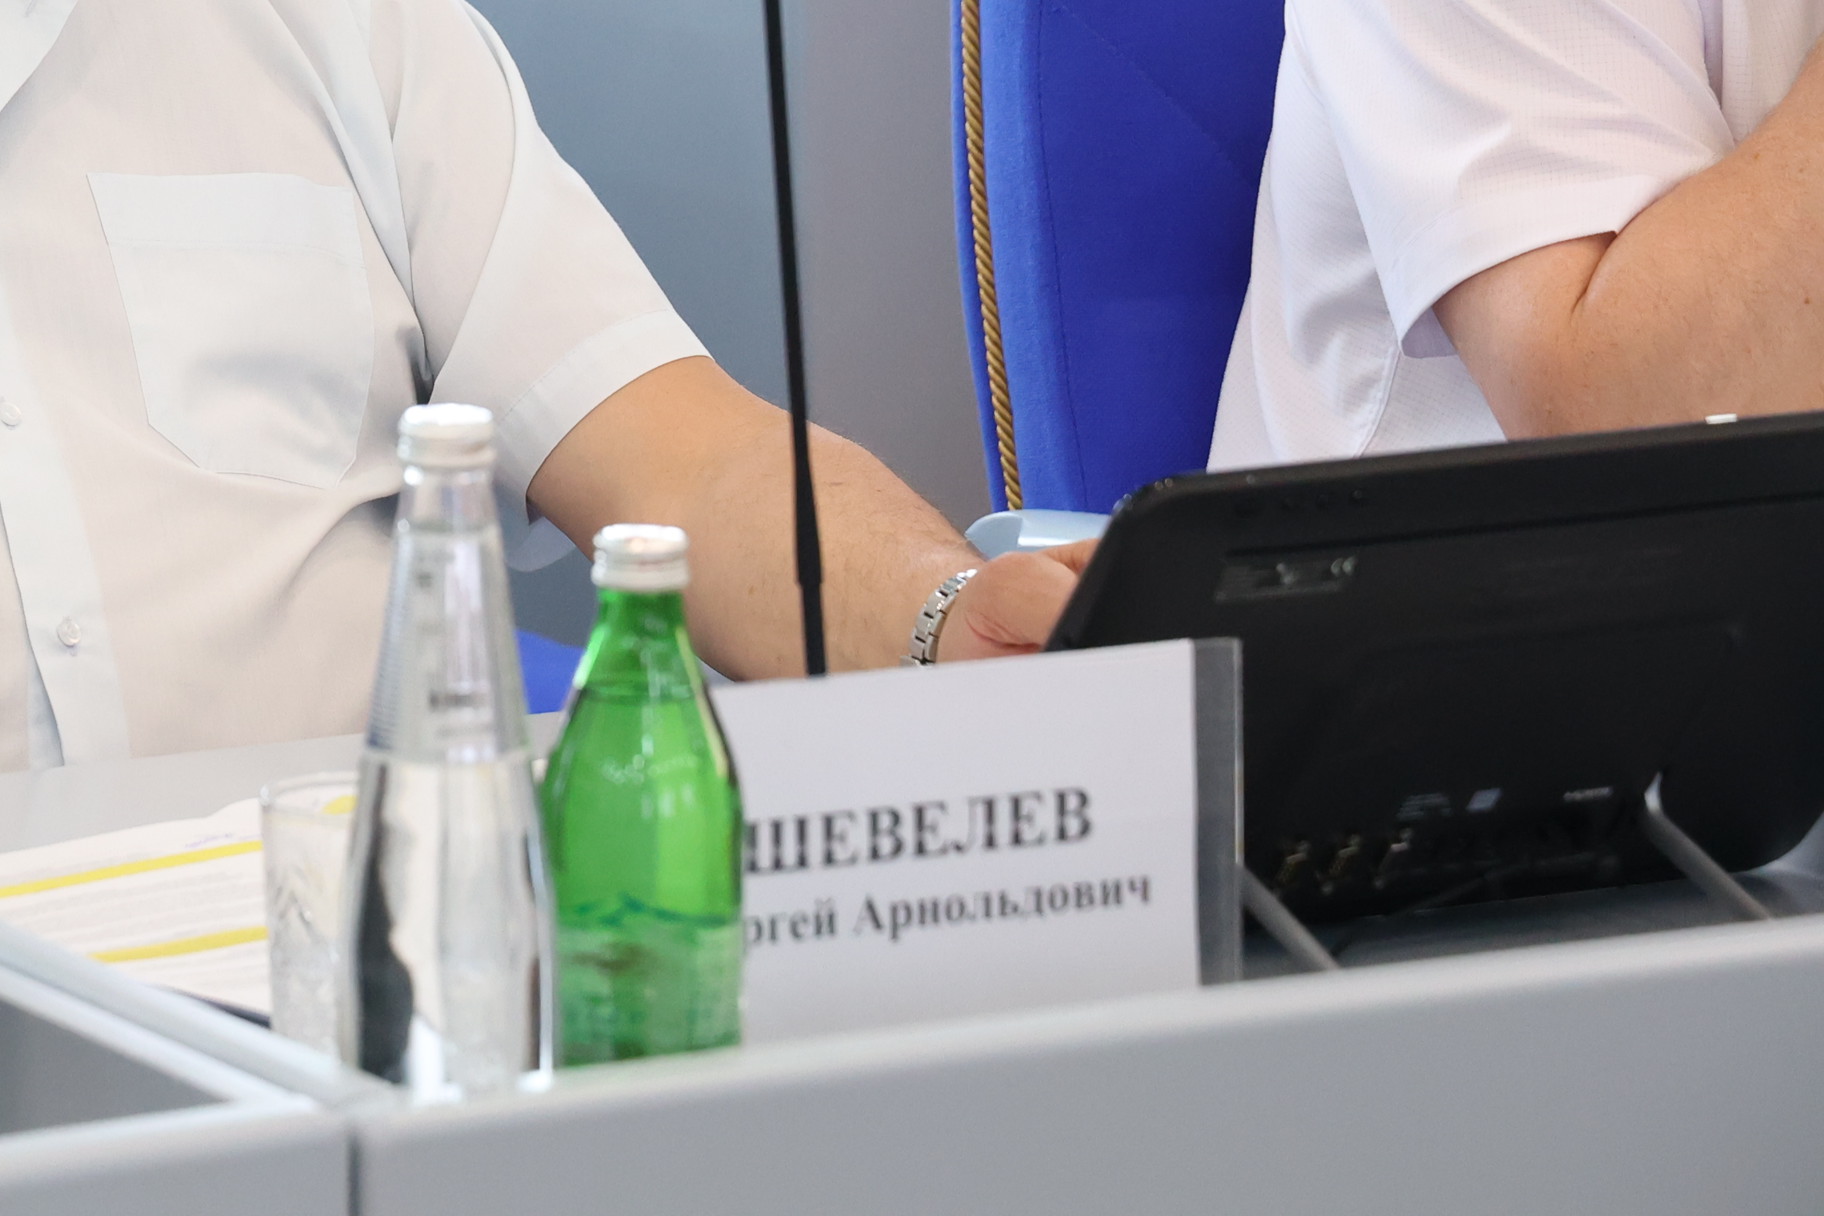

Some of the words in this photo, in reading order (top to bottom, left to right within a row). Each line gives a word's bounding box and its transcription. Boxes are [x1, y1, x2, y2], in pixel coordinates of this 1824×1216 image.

[743, 787, 1092, 876] ШЕВЕЛЕВ
[743, 896, 837, 954] ргей
[852, 877, 1153, 943] Арнольдович
